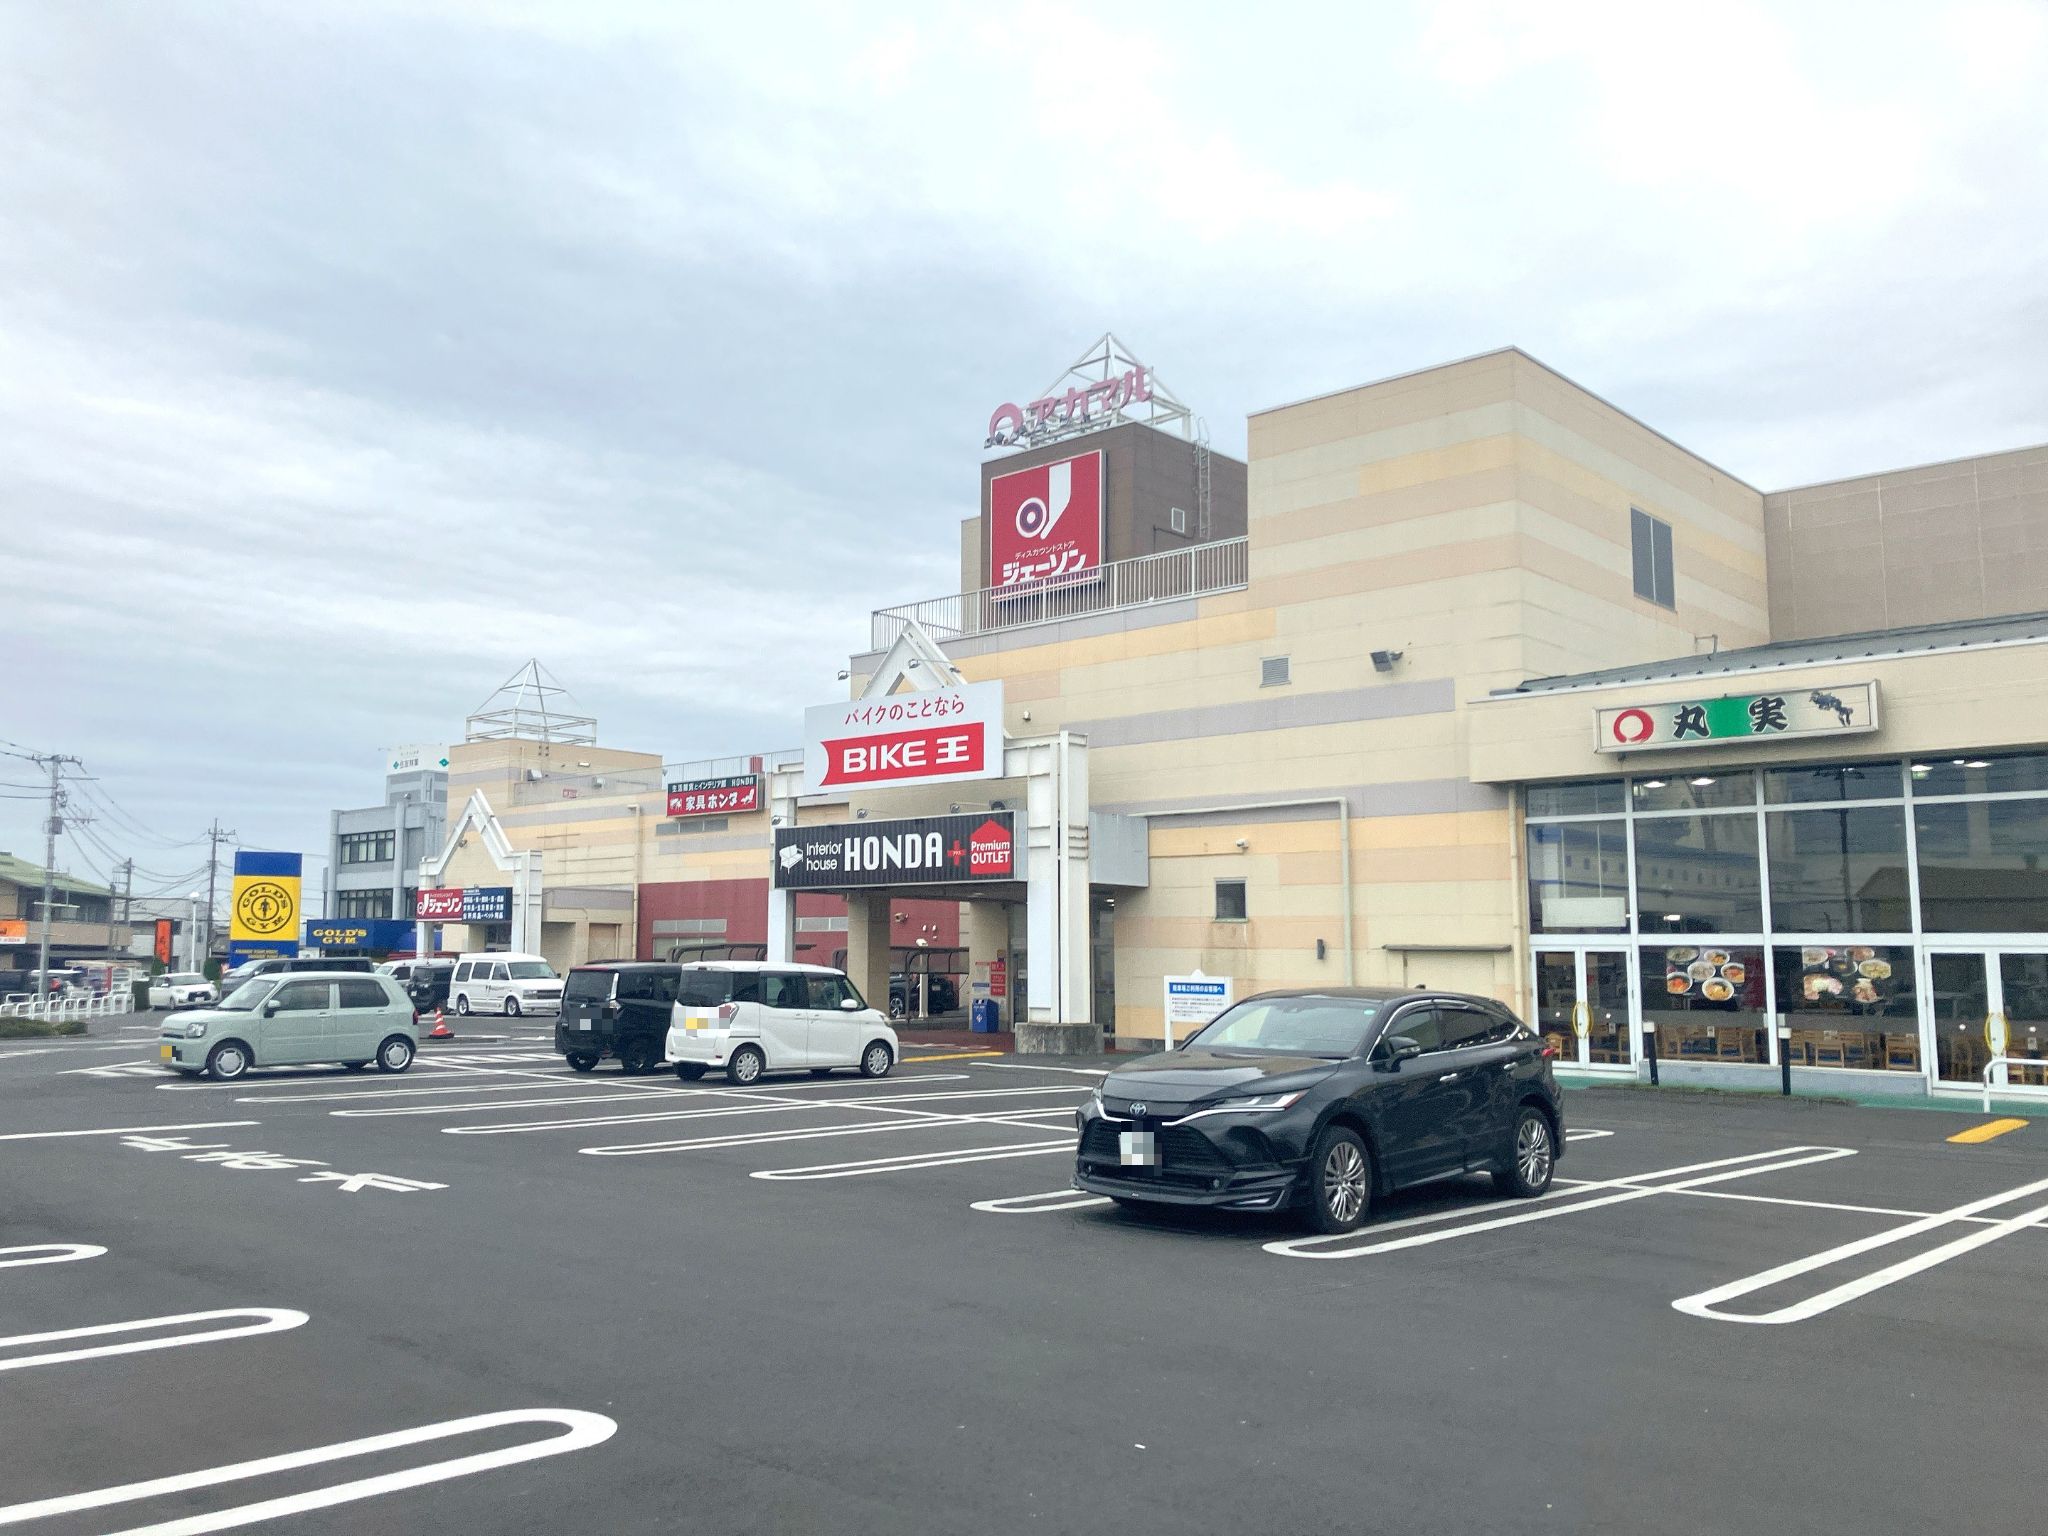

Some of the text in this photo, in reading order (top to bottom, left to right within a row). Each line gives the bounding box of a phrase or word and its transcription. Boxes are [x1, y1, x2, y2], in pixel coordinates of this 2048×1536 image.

[1015, 540, 1076, 560] ディスカウントストア
[1002, 548, 1087, 587] ジェーソン
[844, 694, 966, 726] バイクのことなら
[843, 735, 970, 774] BIKE 王
[806, 841, 843, 856] Interior
[844, 832, 943, 872] HONDA
[970, 840, 1011, 852] Premium
[806, 857, 838, 871] house
[970, 850, 1011, 864] OUTLET
[242, 886, 288, 910] GOLD'S
[246, 916, 285, 930] GYM
[312, 928, 367, 937] GOLD'S
[322, 937, 356, 945] GYM
